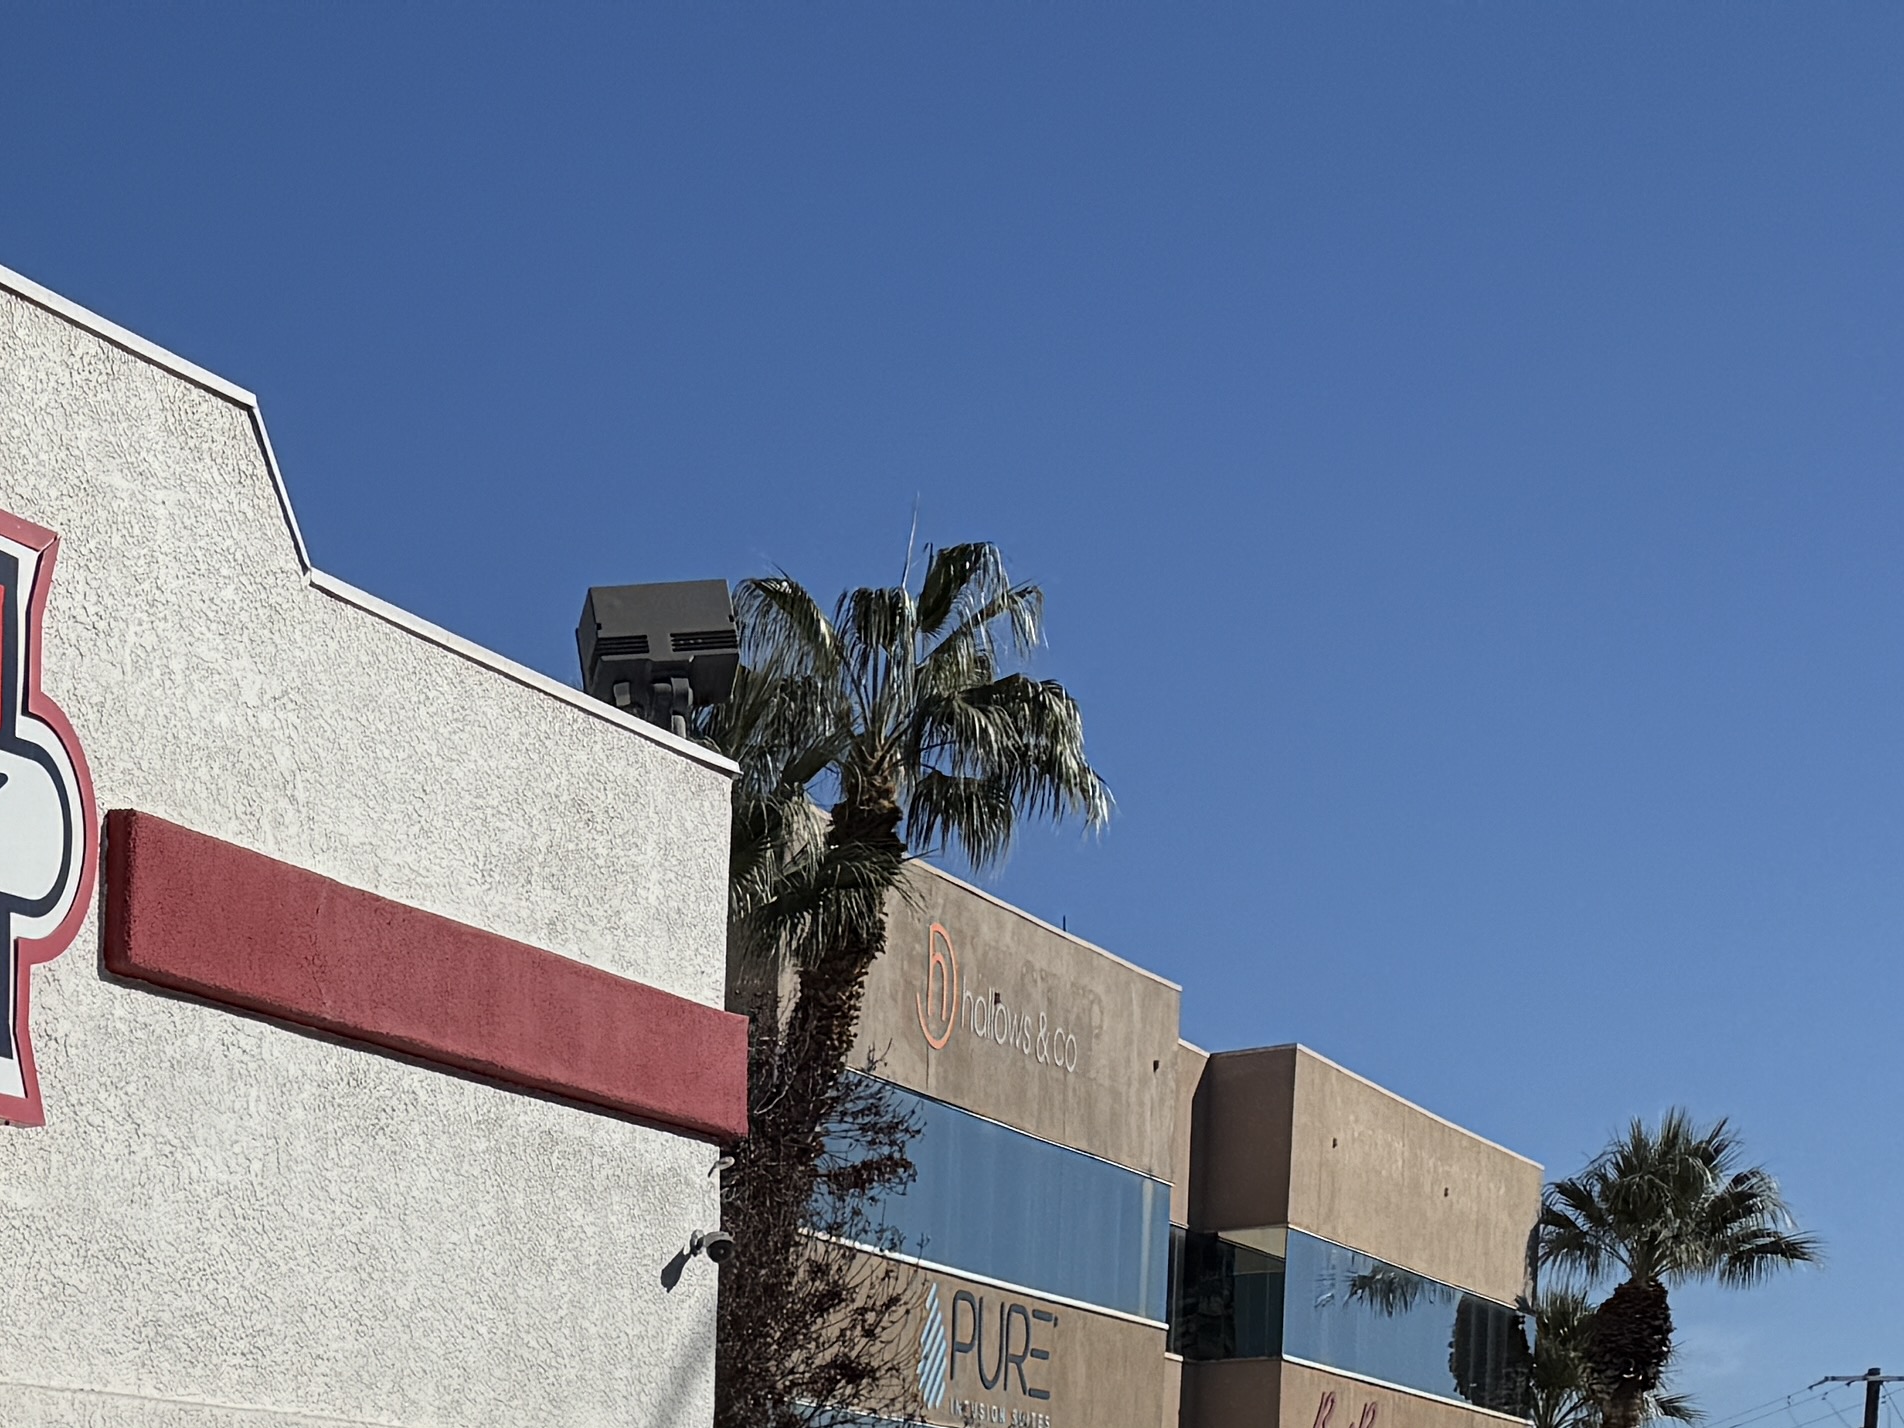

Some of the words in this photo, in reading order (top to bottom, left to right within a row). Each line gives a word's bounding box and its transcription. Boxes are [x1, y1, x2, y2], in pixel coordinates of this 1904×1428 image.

[961, 975, 1032, 1055] hallows
[1036, 1011, 1051, 1065] &
[1053, 1027, 1078, 1073] co
[950, 1289, 1052, 1400] PURE
